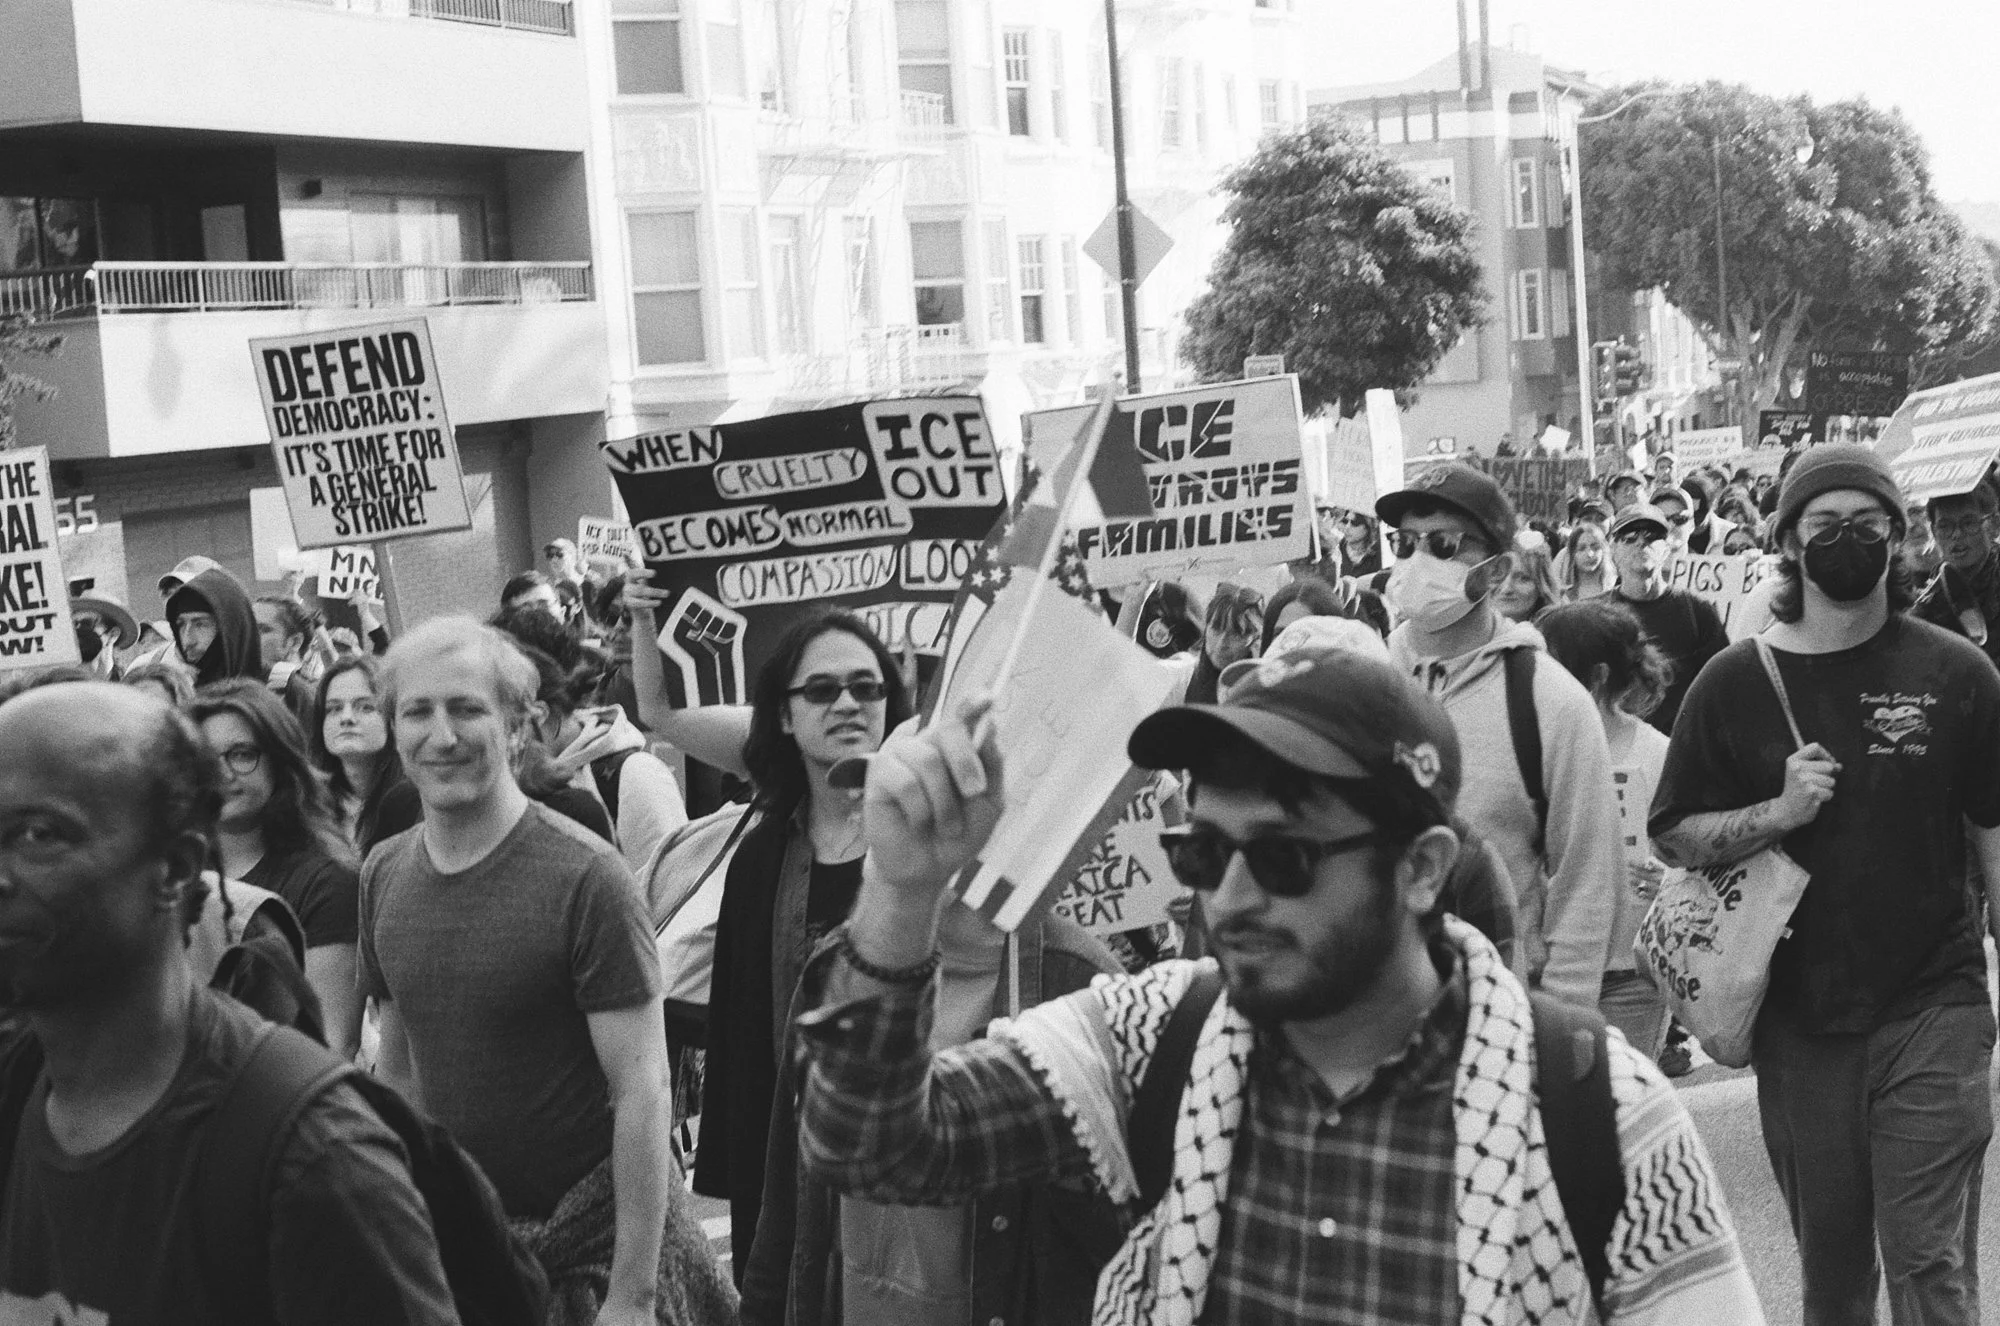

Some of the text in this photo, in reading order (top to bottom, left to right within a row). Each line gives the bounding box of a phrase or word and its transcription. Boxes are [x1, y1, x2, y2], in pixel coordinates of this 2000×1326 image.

[262, 331, 425, 402] DEFEND
[272, 389, 435, 437] DEMOCRACY:
[283, 428, 445, 477] IT'S TIME FOR
[606, 429, 719, 472] WHEN
[876, 412, 992, 462] ICE
[0, 461, 41, 500] HE
[309, 460, 437, 507] A GENERAL
[717, 447, 860, 495] CRUELTY
[890, 466, 994, 501] OUT
[331, 493, 428, 537] STRIKE!
[638, 504, 907, 559] BECOMES NORMAL
[1077, 504, 1294, 560] FAMILIES
[718, 545, 899, 602] COMPASSION
[1673, 560, 1727, 593] PIGS
[1866, 743, 1897, 756] Since
[1061, 854, 1152, 901] RICA
